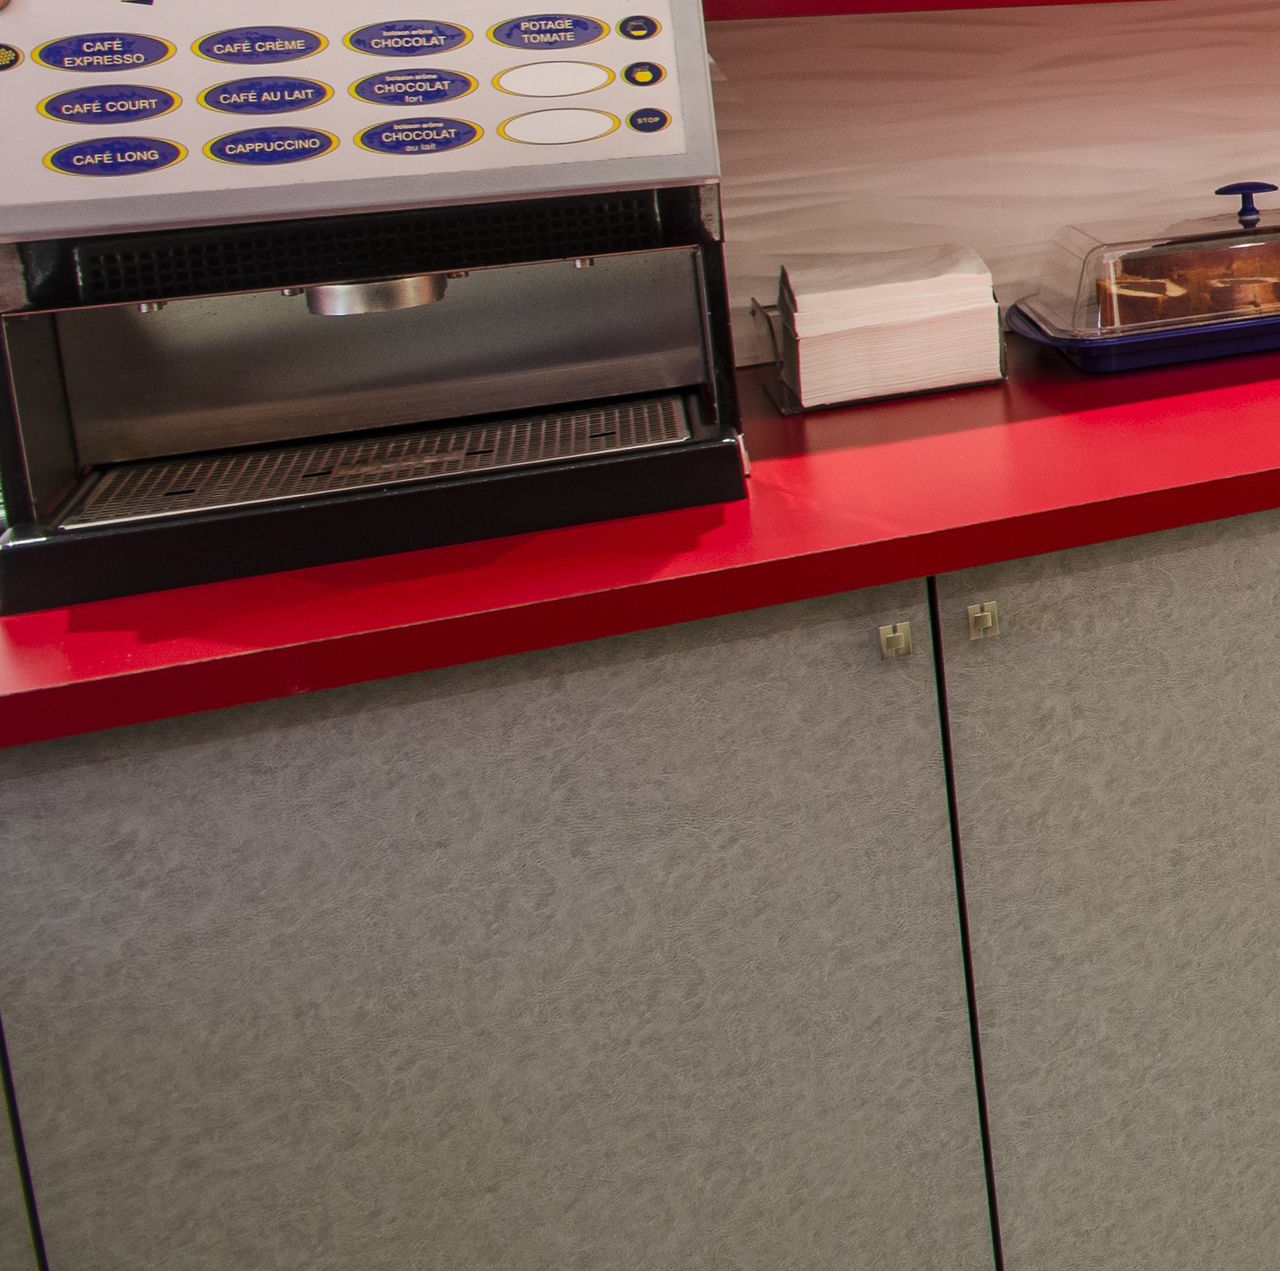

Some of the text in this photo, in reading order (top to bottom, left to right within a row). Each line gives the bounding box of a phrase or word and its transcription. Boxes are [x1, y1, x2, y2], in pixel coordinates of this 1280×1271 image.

[520, 19, 574, 31] POTAGE
[371, 36, 447, 49] CHOCOLAT
[521, 32, 575, 43] TOMATE
[82, 38, 123, 52] CAFÉ
[213, 38, 306, 54] CAFÉ CRÈME
[64, 53, 145, 67] EXPRESSO
[374, 81, 451, 94] CHOCOLAT
[219, 89, 314, 104] CAFÉ AU LAIT
[404, 95, 423, 103] fort
[62, 99, 158, 115] CAFÉ COURT
[636, 116, 660, 124] STOP
[382, 129, 457, 142] CHOCOLAT
[225, 138, 320, 155] CAPPUCCINO
[421, 143, 437, 151] lait
[72, 149, 159, 166] CAFÉ LONG
